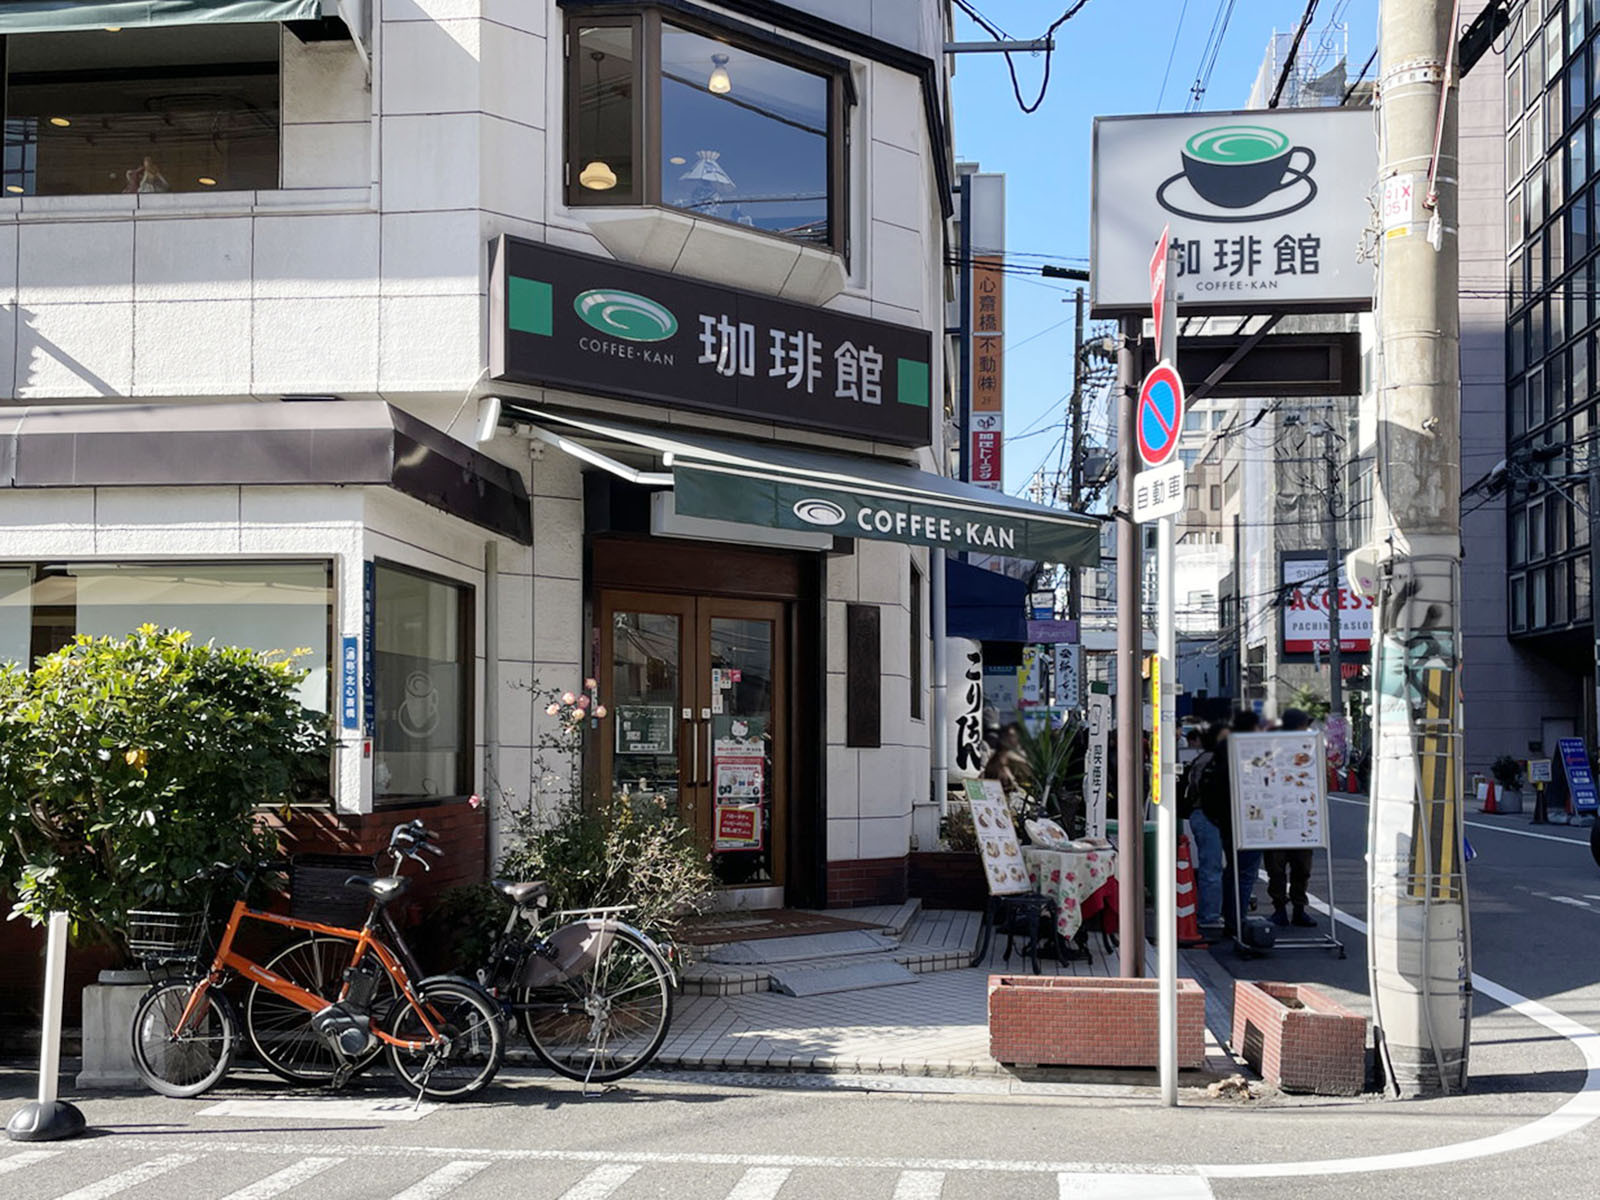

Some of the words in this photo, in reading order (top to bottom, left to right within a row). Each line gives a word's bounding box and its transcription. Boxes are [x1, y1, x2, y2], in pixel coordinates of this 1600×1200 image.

[698, 313, 884, 405] 珈琲館
[1137, 475, 1181, 510] 自動車
